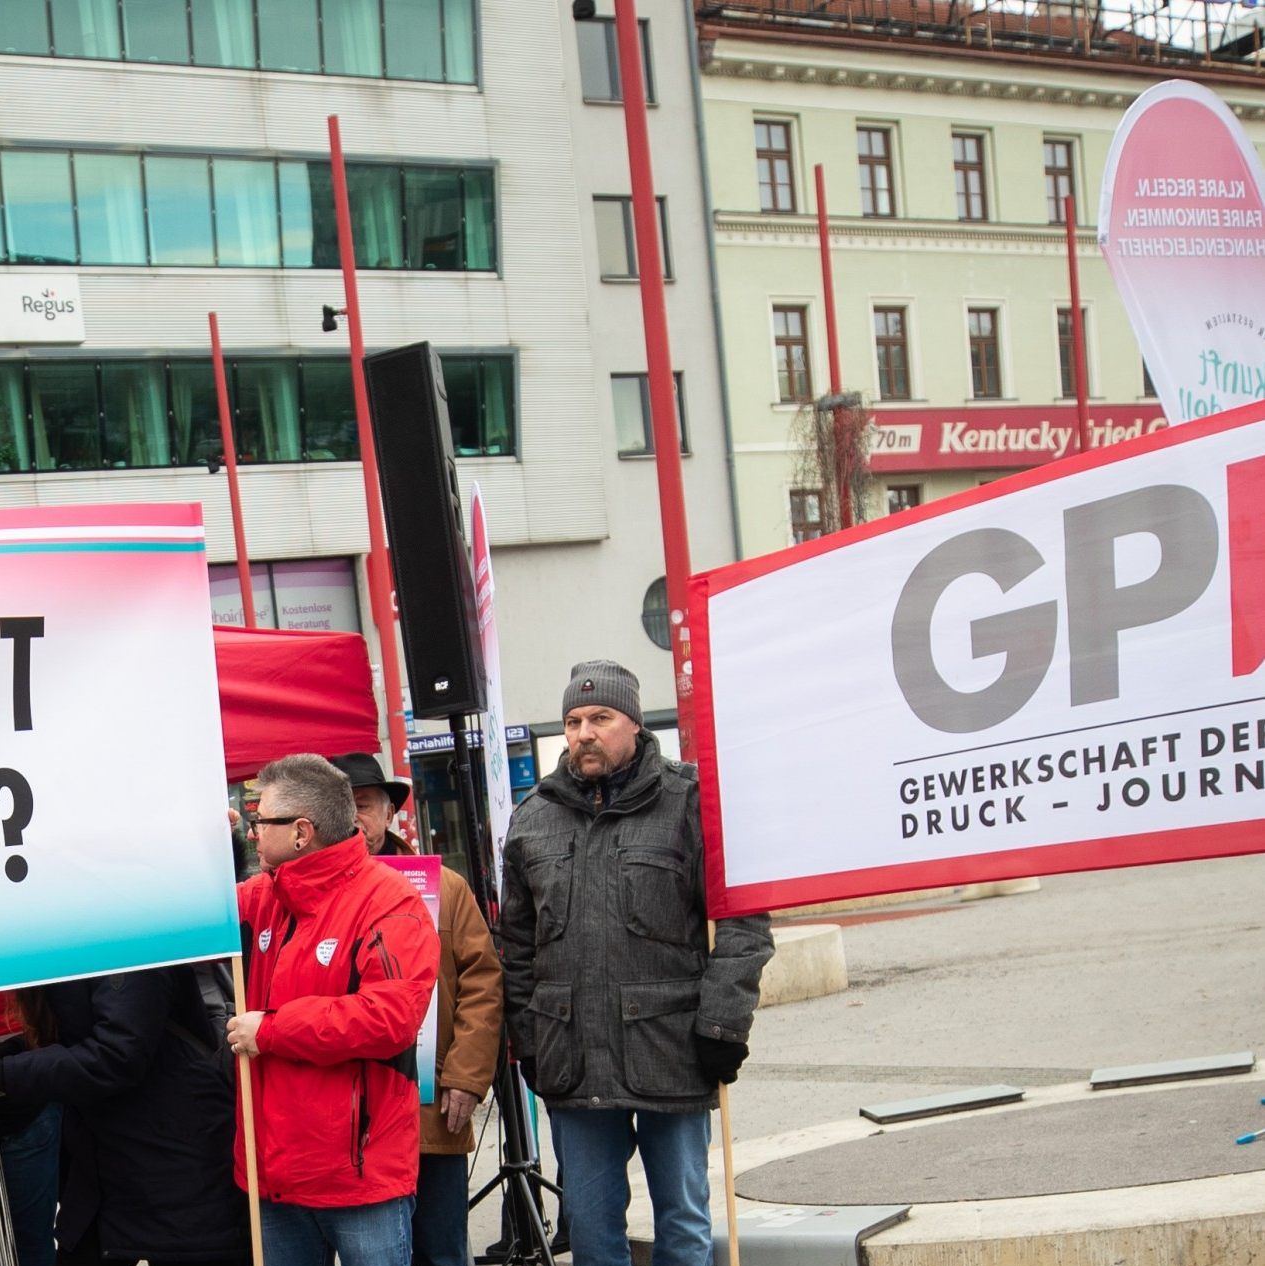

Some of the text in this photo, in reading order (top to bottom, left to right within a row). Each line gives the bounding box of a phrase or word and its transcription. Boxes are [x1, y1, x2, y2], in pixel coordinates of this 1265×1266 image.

[22, 295, 75, 321] Regus
[939, 421, 1072, 459] Kentucky
[282, 602, 332, 615] Kostenlose
[288, 618, 330, 630] Beratung
[506, 727, 525, 738] 123
[899, 732, 1181, 804] GEWERKSCHAFT
[901, 794, 1027, 839] DRUCK
